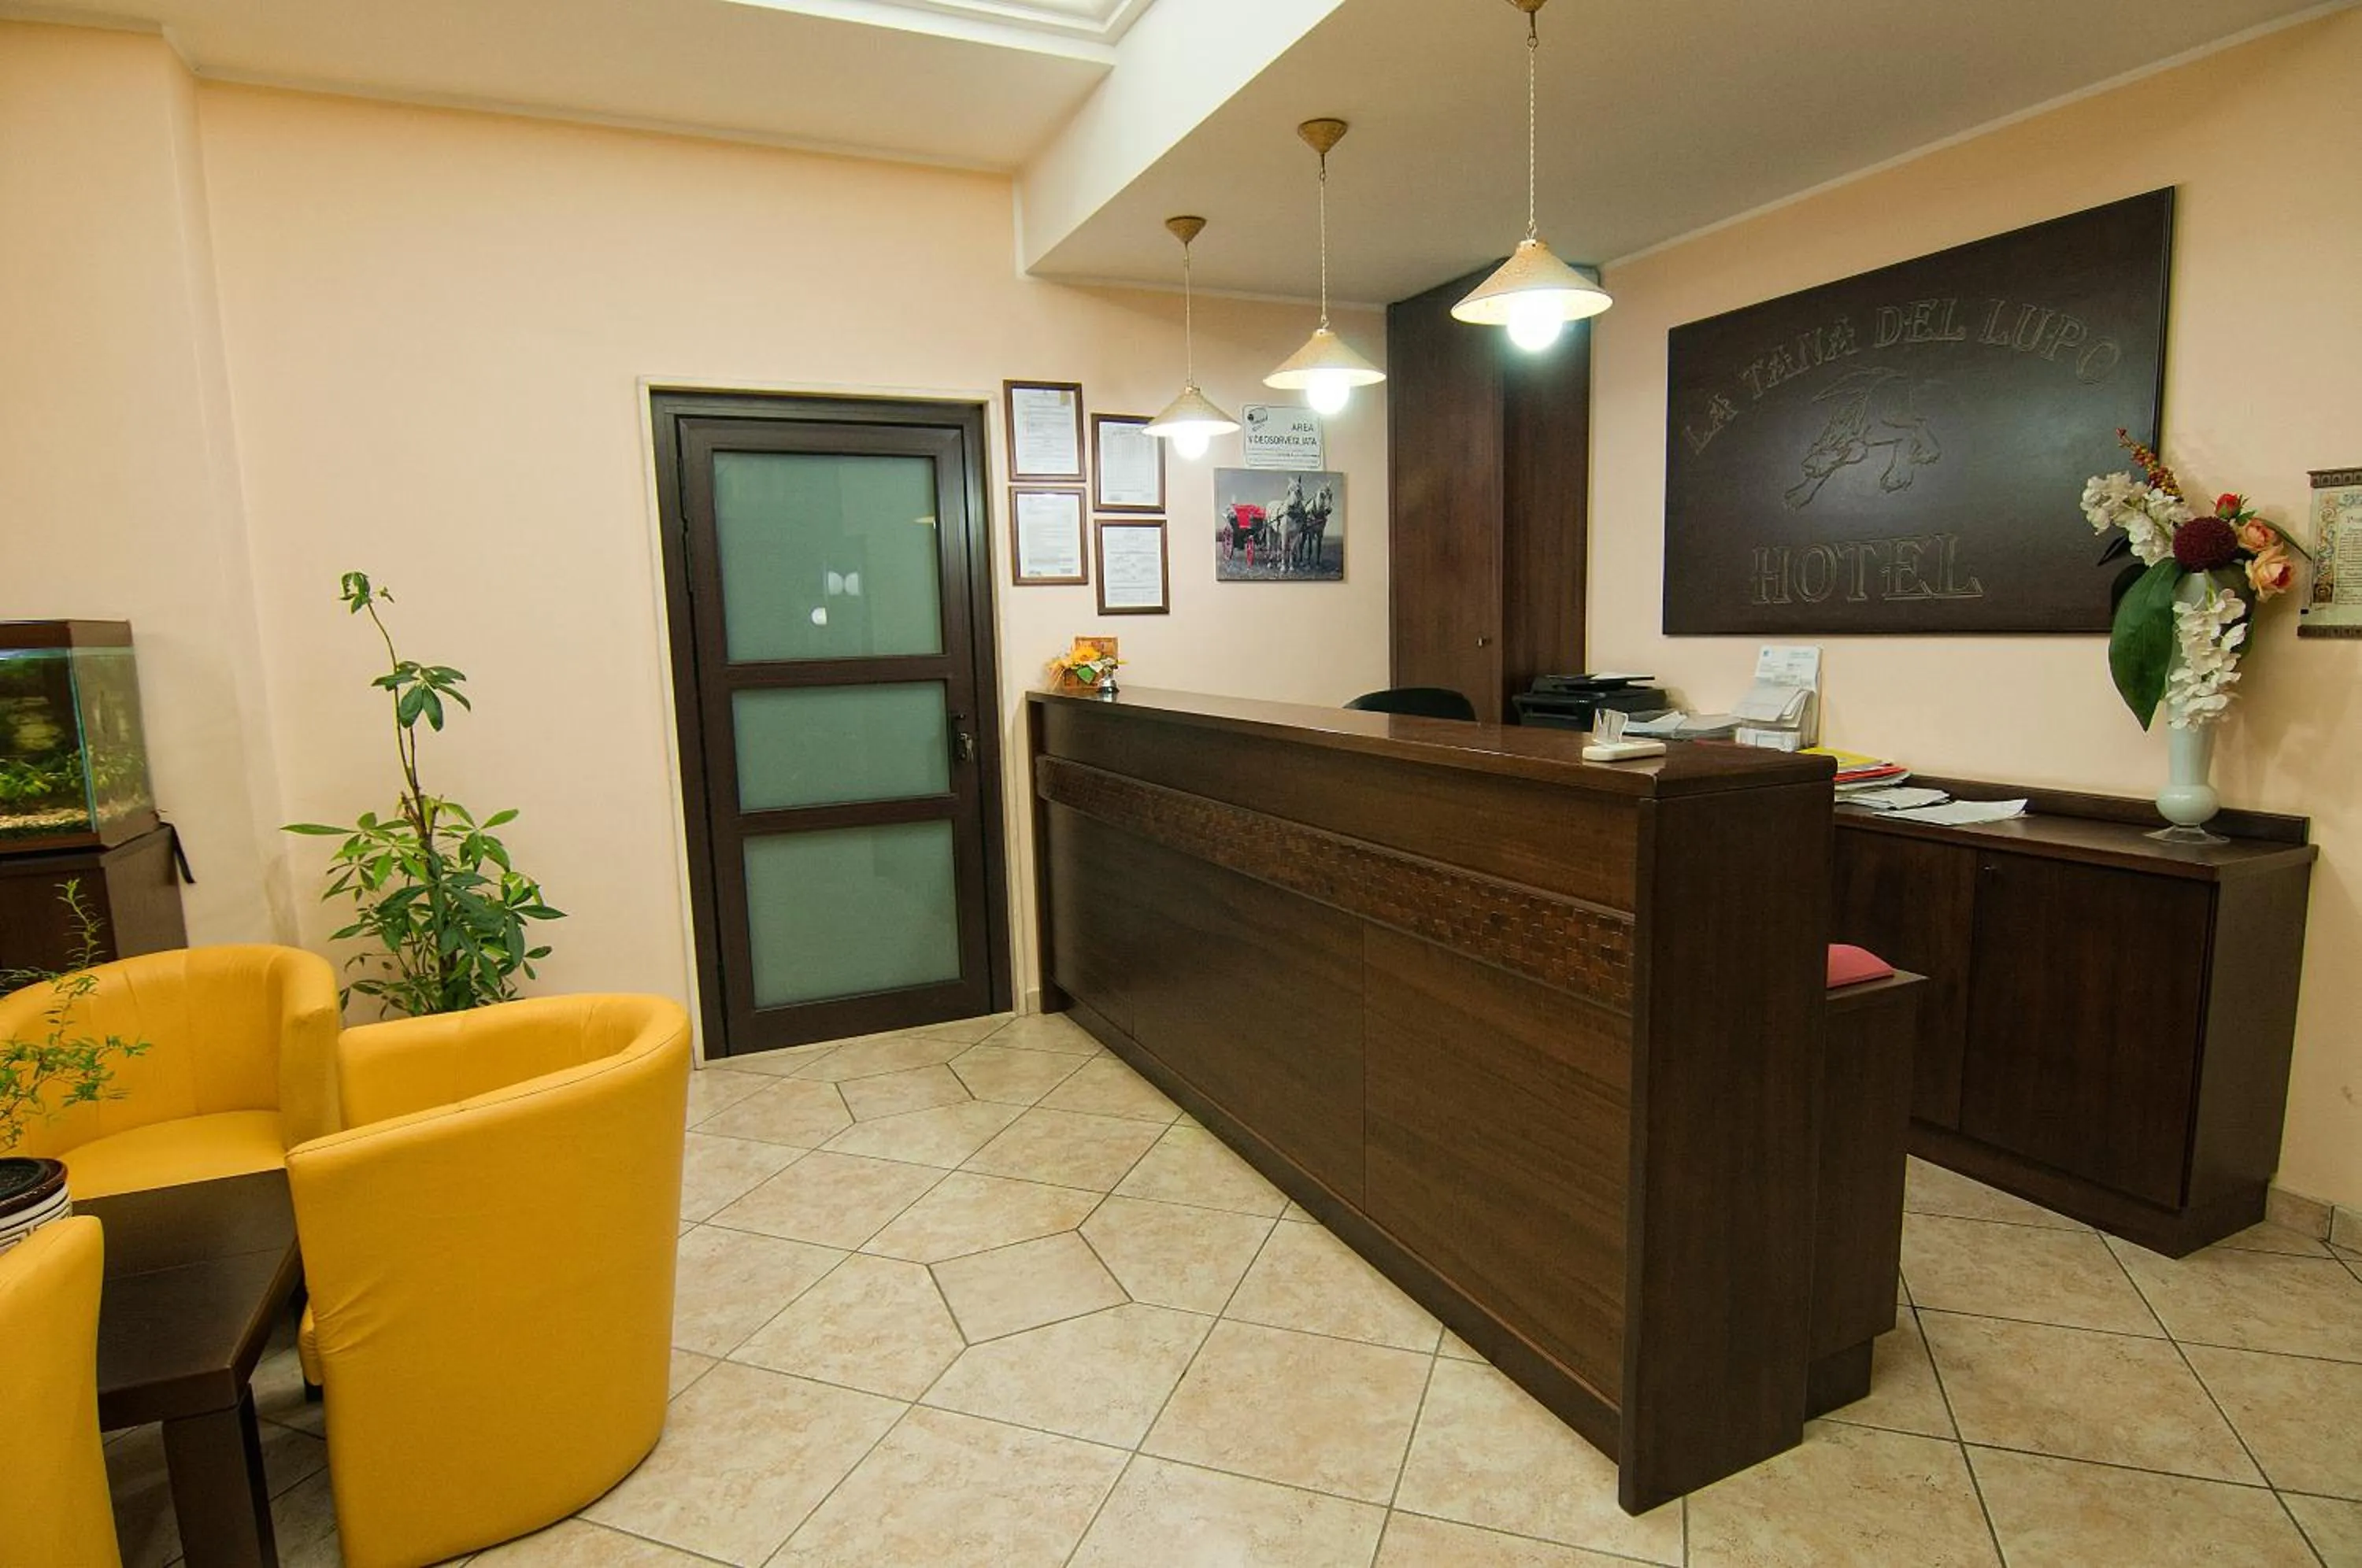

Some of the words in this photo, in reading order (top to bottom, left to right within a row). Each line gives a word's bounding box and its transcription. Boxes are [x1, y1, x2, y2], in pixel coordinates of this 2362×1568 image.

[1683, 394, 1738, 455] LA
[1738, 315, 1861, 400] TANA
[1872, 298, 1966, 349] DEL
[1977, 298, 2122, 386] LUPO
[1292, 423, 1314, 432] AREA
[1750, 533, 1983, 604] HOTEL
